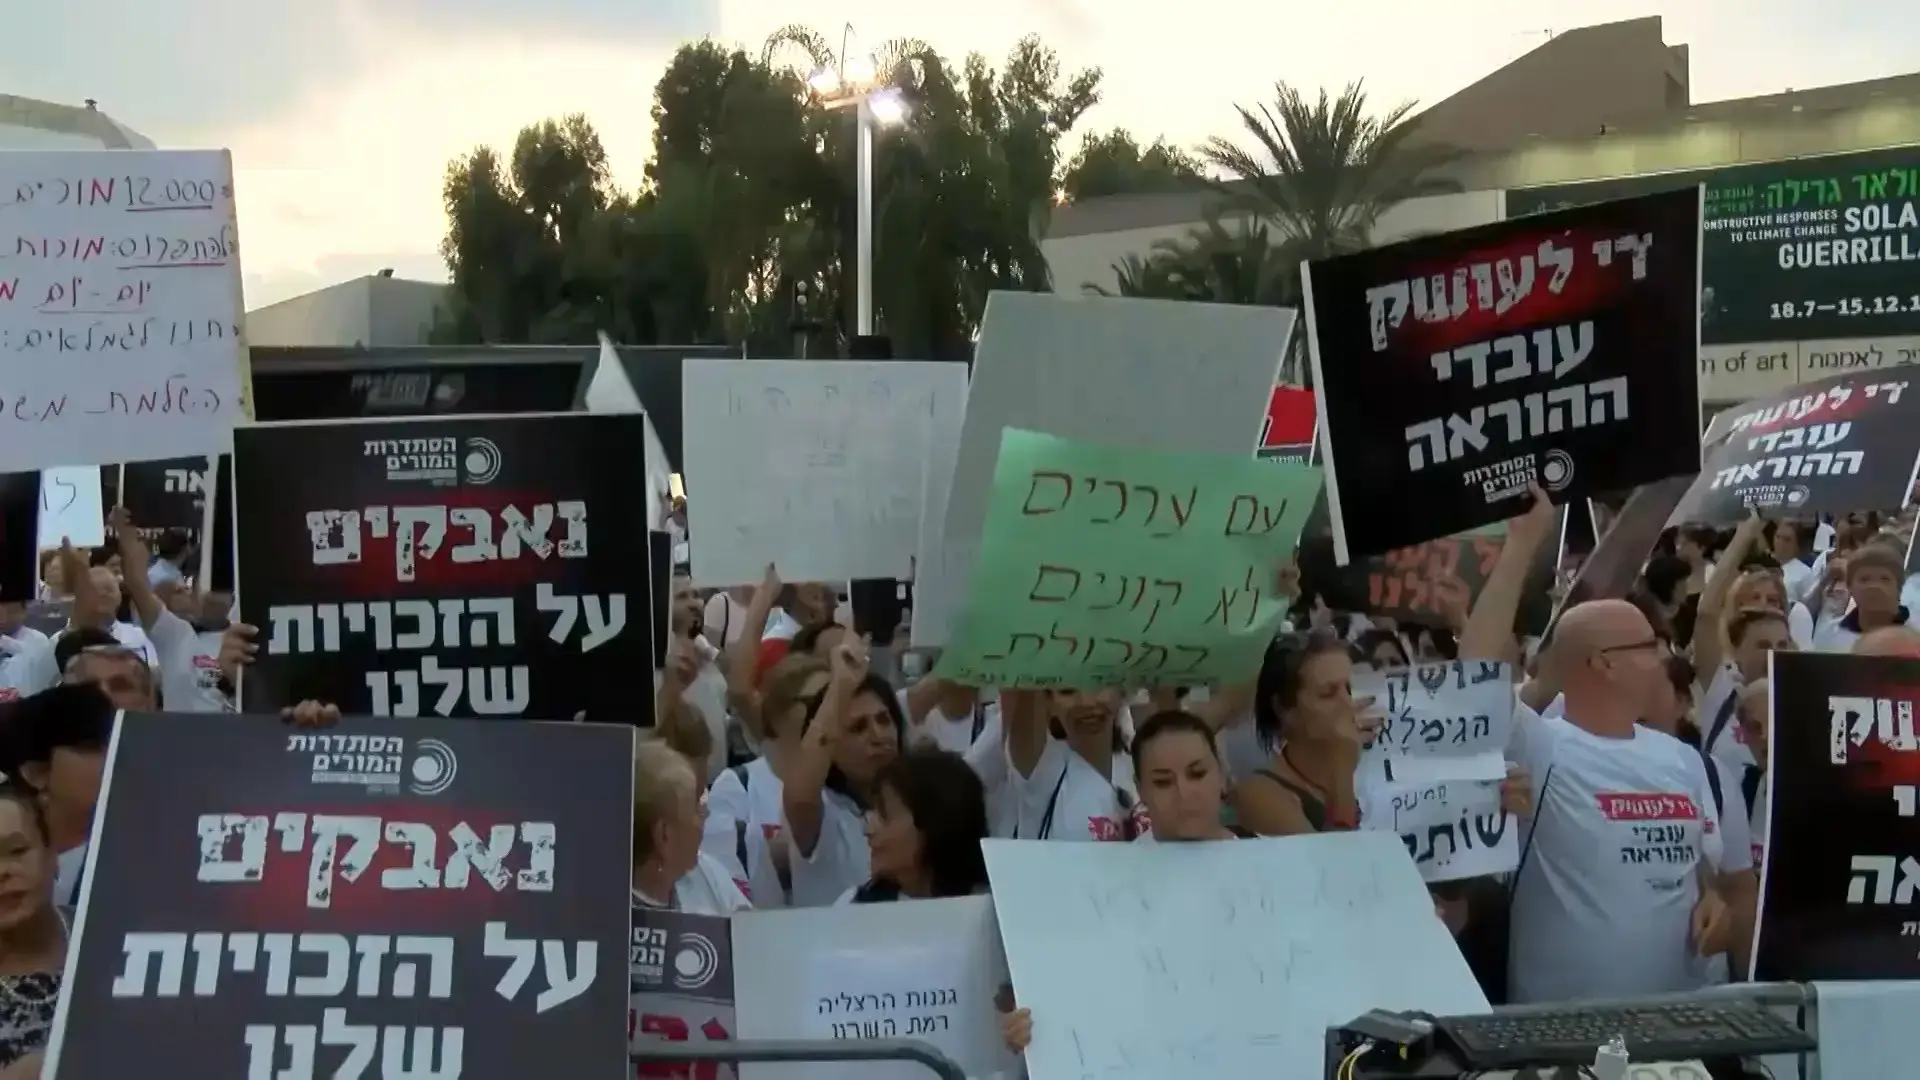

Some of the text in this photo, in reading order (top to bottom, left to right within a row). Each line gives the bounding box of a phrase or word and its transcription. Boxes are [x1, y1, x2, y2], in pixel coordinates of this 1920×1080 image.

[1730, 223, 1838, 244] TO CLIMATE CHANGE
[1775, 209, 1838, 225] RESPONSES
[1844, 201, 1919, 234] SOLA
[1366, 230, 1653, 352] די לעושק
[1431, 320, 1595, 388] עובדי
[1725, 350, 1748, 373] of
[1756, 351, 1788, 371] art
[1405, 376, 1629, 471] ההוראה
[1747, 421, 1852, 452] עובדי
[363, 436, 457, 456] הסתדרות
[386, 454, 457, 470] המורים
[1463, 453, 1536, 485] הסתדרות
[1482, 467, 1537, 494] המורים
[1710, 450, 1864, 490] ההוראה
[1022, 470, 1287, 537] עם ערכים
[306, 500, 588, 582] נאבקים
[1029, 564, 1259, 633] לא קונים
[268, 583, 627, 655] על הזכויות
[365, 656, 530, 717] שלנו
[286, 734, 404, 753] הסתדרות
[312, 753, 403, 773] המורים
[1632, 824, 1685, 844] עובדי
[197, 812, 556, 909] נאבקים
[1621, 844, 1695, 864] ההוראה
[111, 921, 598, 1014] על הזכויות
[818, 986, 959, 1015] גננות הרצליה
[906, 1013, 950, 1035] רמת
[243, 1007, 465, 1080] שלנו
